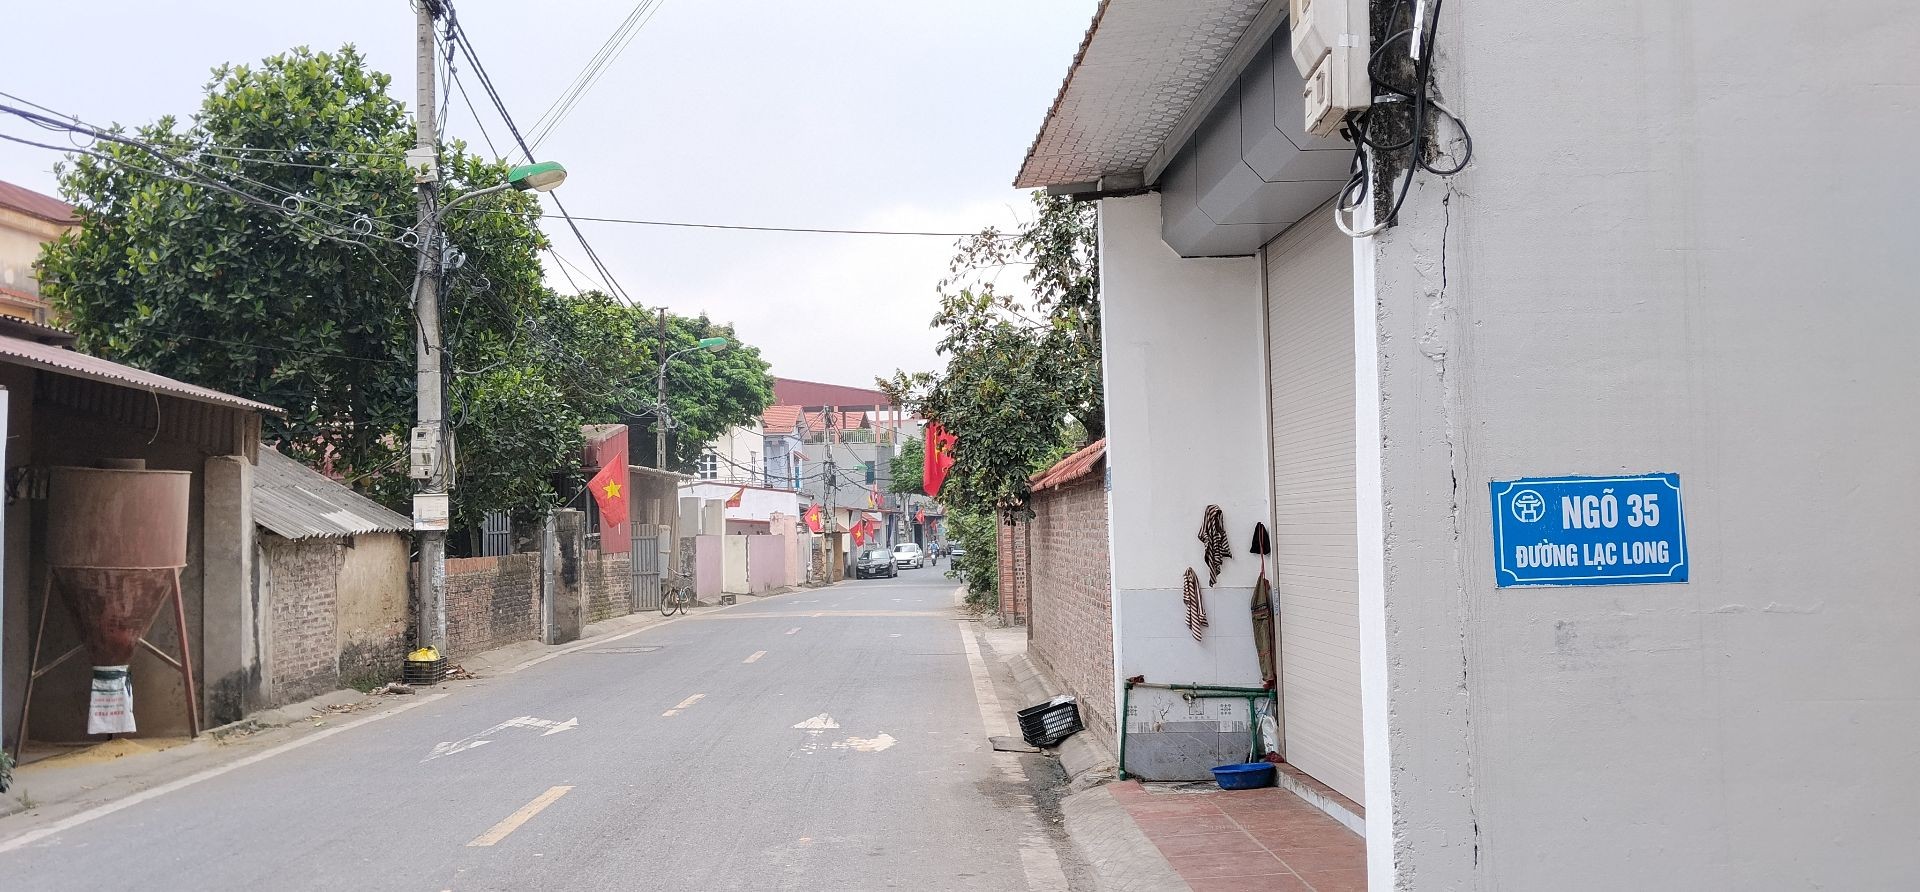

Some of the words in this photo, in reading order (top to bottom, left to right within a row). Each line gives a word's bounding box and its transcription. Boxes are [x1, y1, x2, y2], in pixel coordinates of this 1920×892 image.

[1561, 488, 1619, 530] NGÕ
[1626, 493, 1660, 528] 35
[1515, 539, 1579, 568] ĐƯỜNG
[1584, 542, 1618, 571] LẠC
[1622, 540, 1670, 565] LONG
